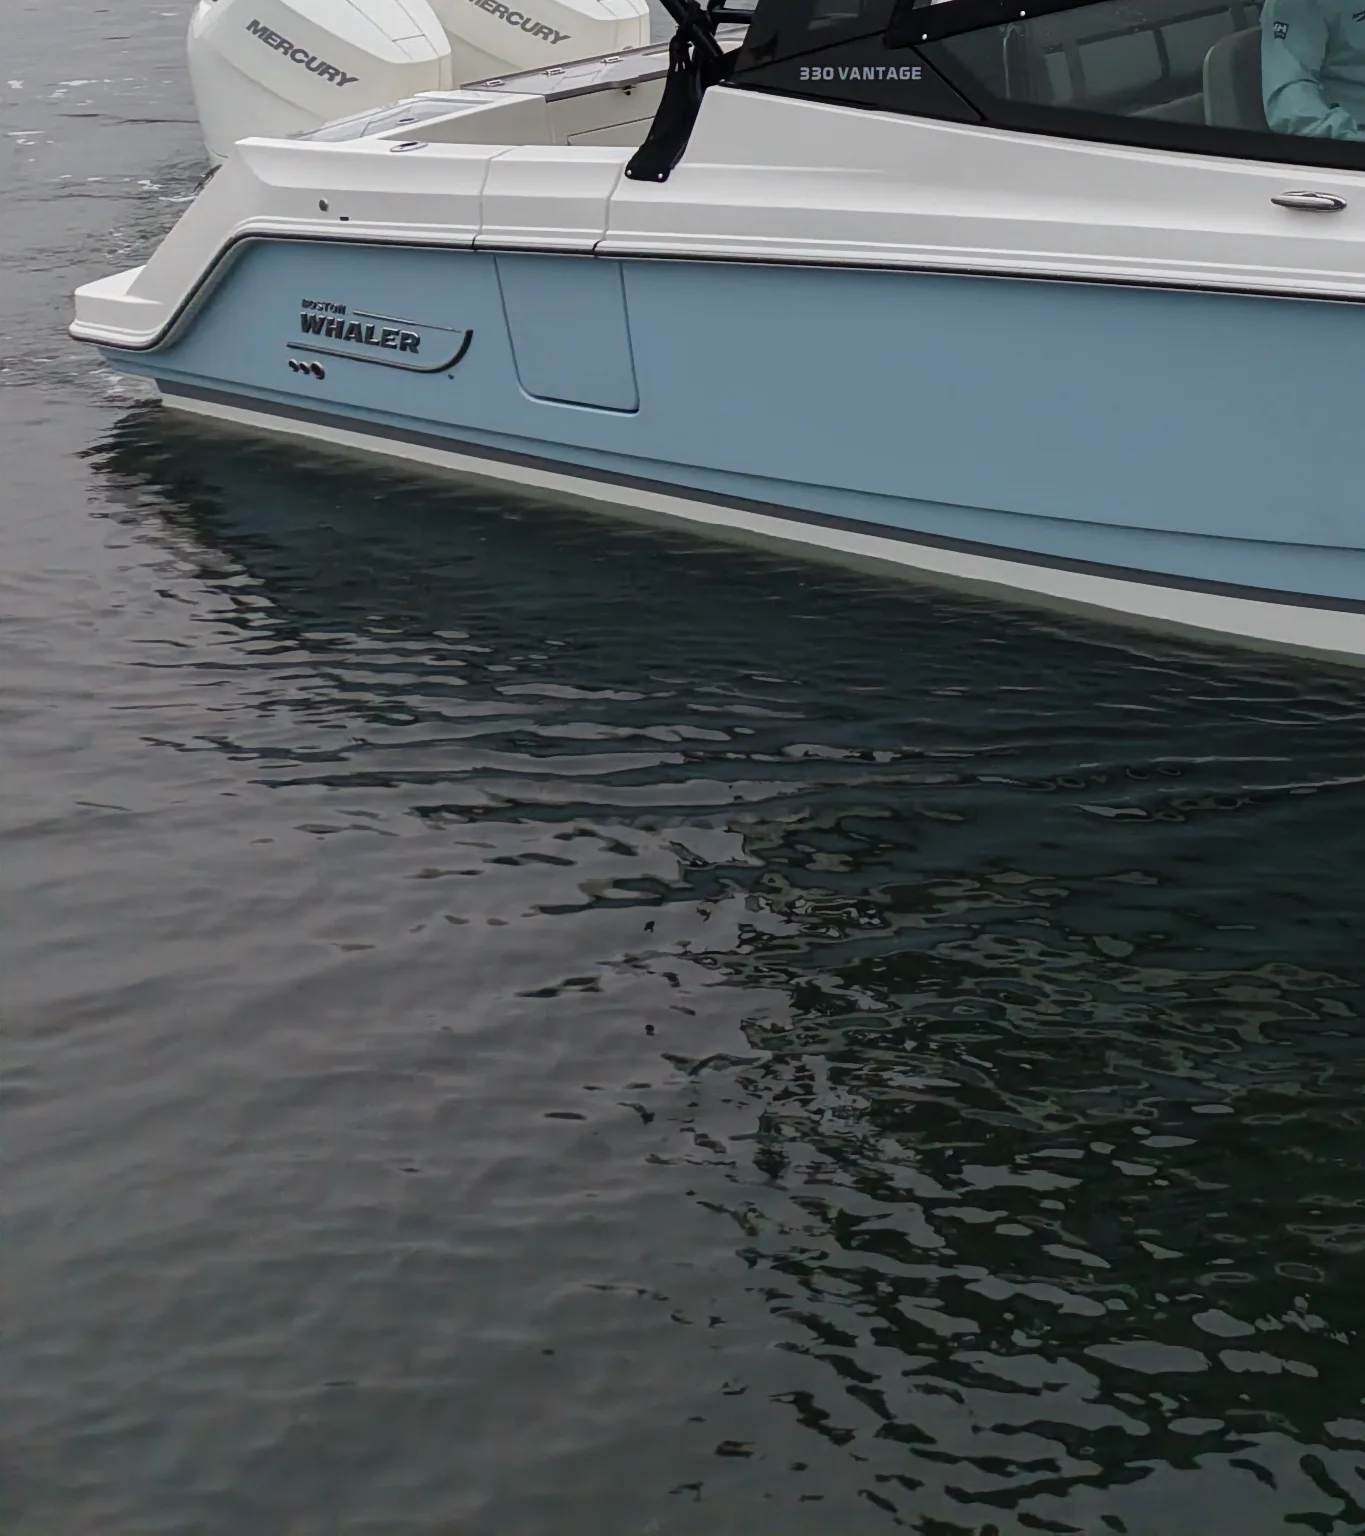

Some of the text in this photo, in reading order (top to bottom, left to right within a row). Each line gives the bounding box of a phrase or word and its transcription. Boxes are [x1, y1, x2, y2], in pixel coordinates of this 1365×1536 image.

[245, 18, 360, 87] MERCURY
[799, 66, 922, 81] 330 VANTAGE
[300, 311, 421, 354] WHALER
